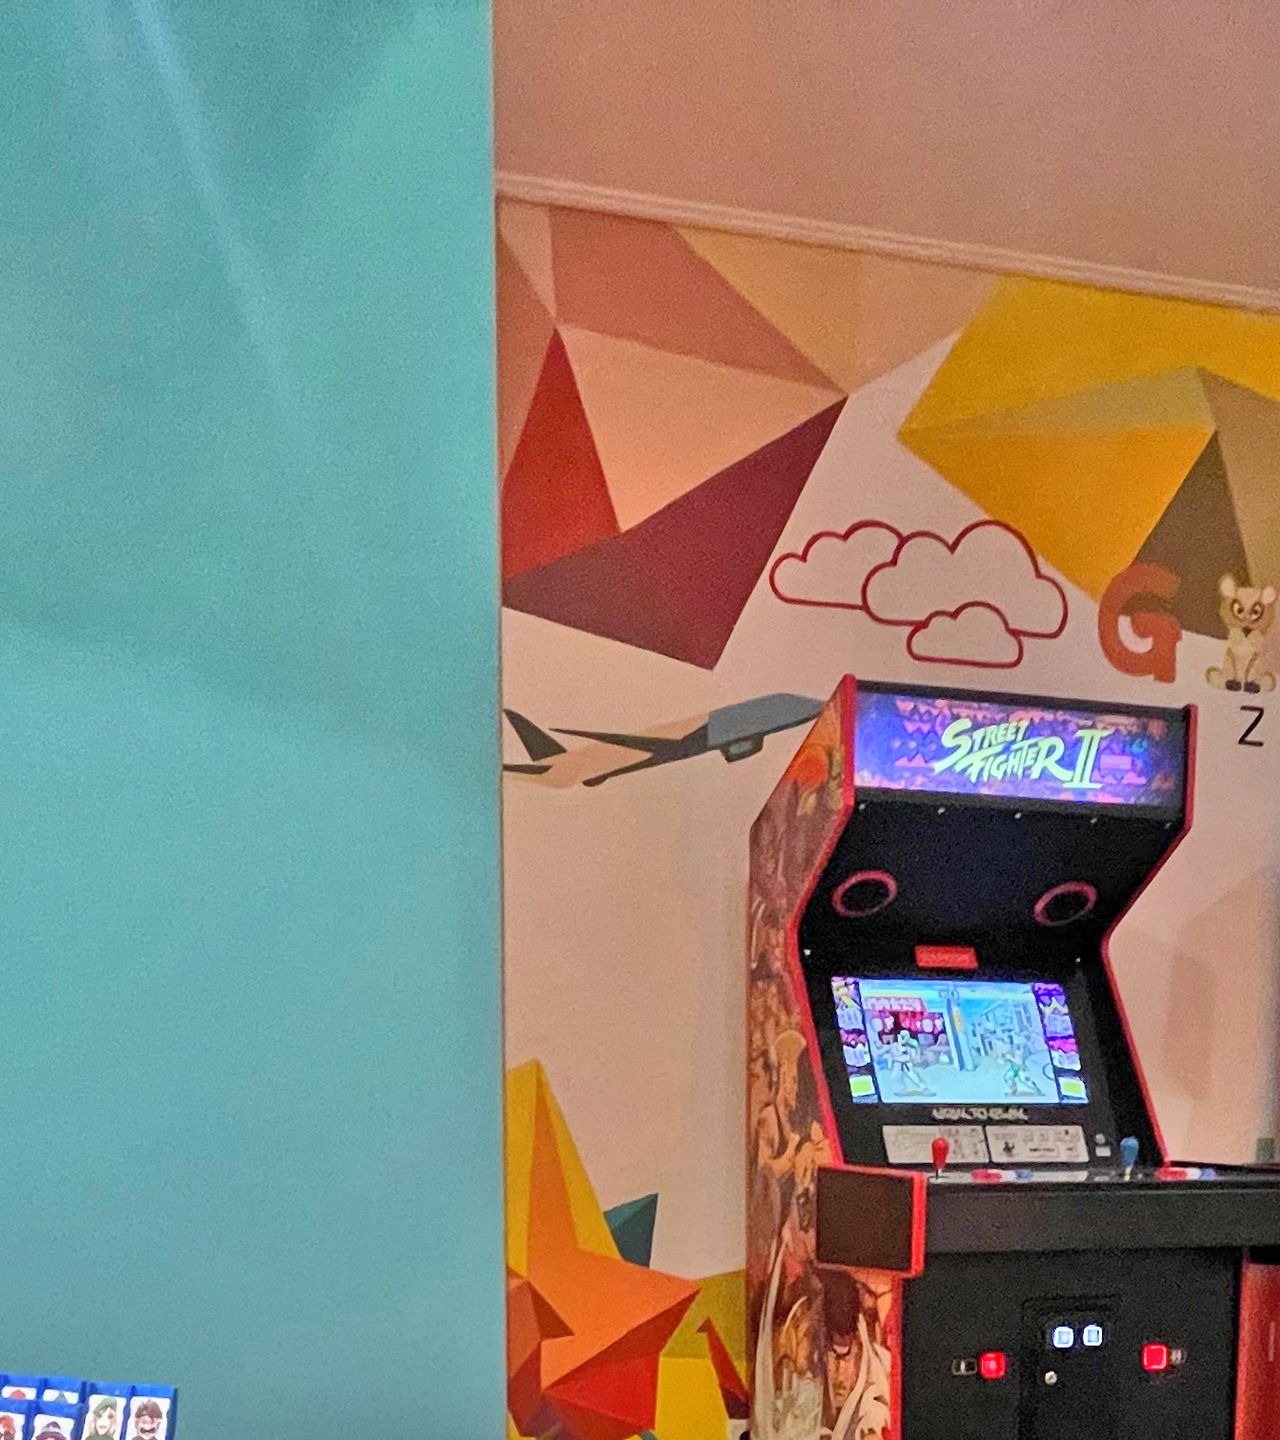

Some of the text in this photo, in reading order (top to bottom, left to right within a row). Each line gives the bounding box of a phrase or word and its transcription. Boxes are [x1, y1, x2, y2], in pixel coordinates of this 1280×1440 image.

[933, 717, 1029, 774] STREET
[956, 727, 1115, 789] FIGHTER II
